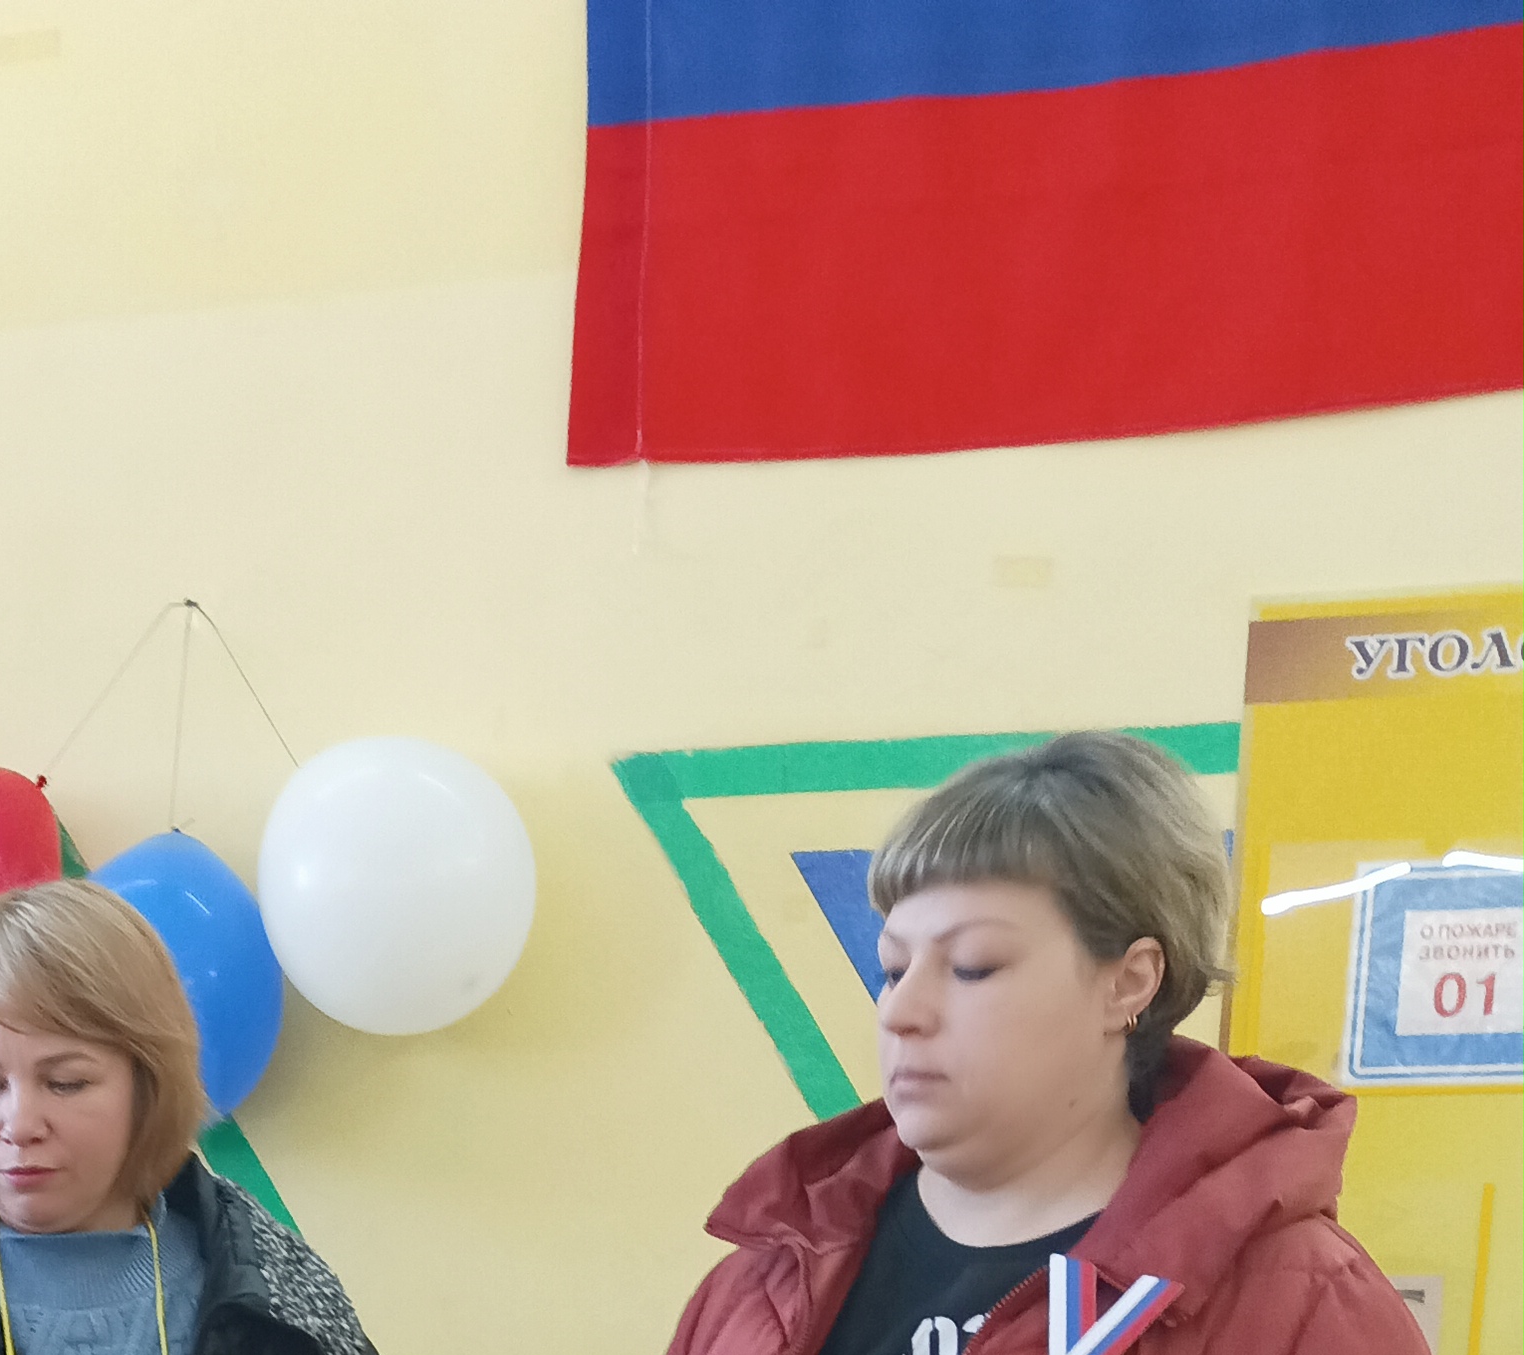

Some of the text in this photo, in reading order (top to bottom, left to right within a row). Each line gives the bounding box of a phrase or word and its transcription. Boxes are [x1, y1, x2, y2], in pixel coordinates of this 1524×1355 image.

[1348, 630, 1524, 677] УГОЛ
[1438, 921, 1517, 939] ПОЖАРЕ
[1418, 944, 1516, 961] ЗВОНИТЬ
[1433, 972, 1496, 1018] 01
